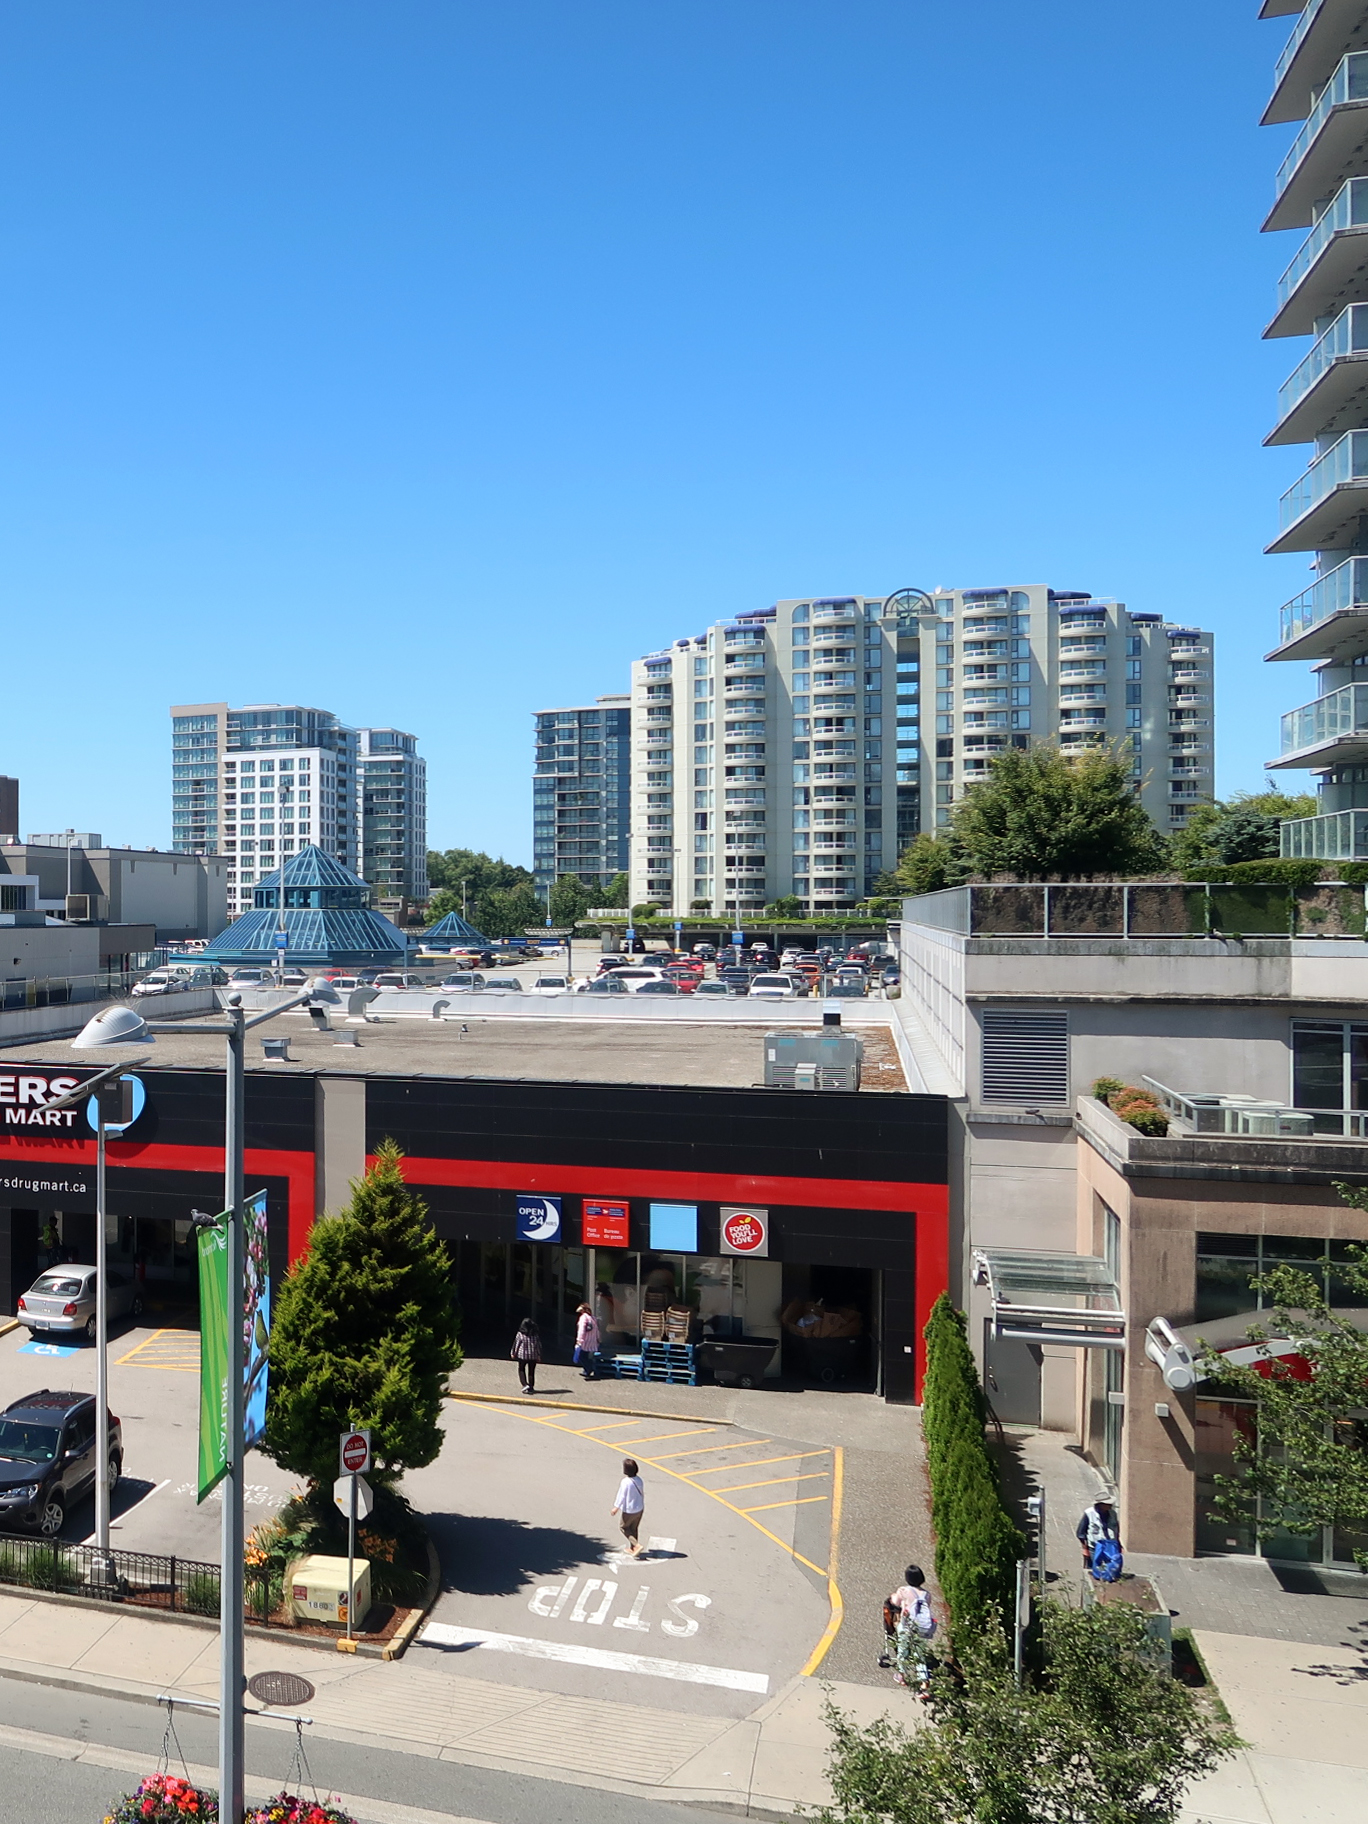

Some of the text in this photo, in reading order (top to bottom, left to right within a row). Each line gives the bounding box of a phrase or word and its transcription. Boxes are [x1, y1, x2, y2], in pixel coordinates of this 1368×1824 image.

[5, 1107, 78, 1127] MART
[518, 1206, 545, 1216] OPEN
[529, 1215, 544, 1226] 24
[728, 1224, 751, 1234] FOOD
[731, 1228, 759, 1239] YOU'LL
[732, 1236, 754, 1246] LOVE
[354, 1441, 364, 1449] NOT
[347, 1457, 363, 1465] ENTER
[527, 1576, 712, 1637] STOP
